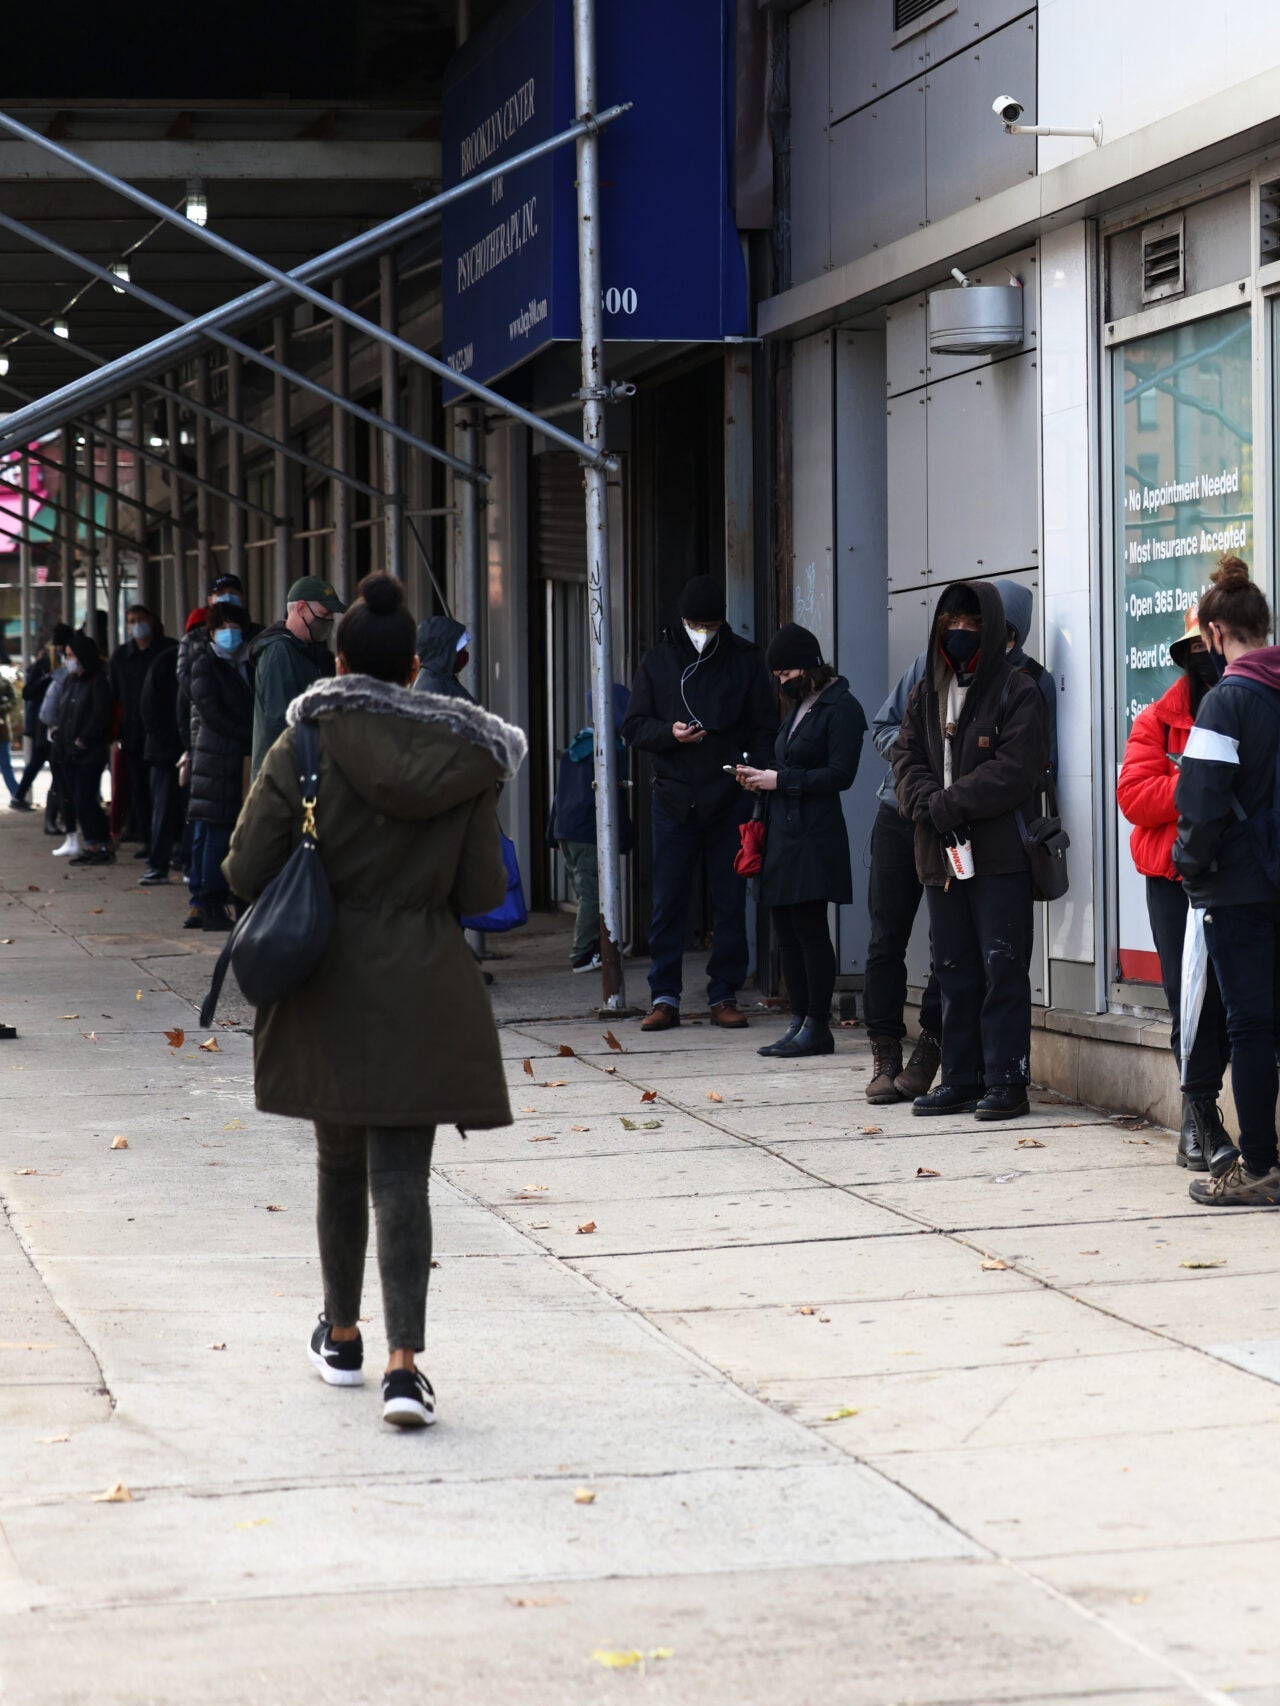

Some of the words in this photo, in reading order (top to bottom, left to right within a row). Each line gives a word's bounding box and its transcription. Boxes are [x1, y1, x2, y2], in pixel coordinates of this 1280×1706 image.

[460, 107, 503, 178] BROOKLYN
[503, 77, 535, 140] CENTER
[457, 209, 522, 294] PSYCHOTHERAPY,
[522, 196, 538, 242] INC.
[601, 287, 638, 314] 00
[1129, 488, 1141, 511] No
[1143, 475, 1199, 514] Appointment
[1201, 467, 1239, 498] Needed
[1129, 538, 1151, 564] Most
[1153, 535, 1198, 560] Insurance
[1200, 521, 1246, 554] Accepted
[1130, 593, 1153, 622] Open
[1154, 590, 1173, 614] 365
[1175, 588, 1199, 611] Days
[1130, 644, 1157, 669] Board
[950, 847, 965, 874] UNKIN'
